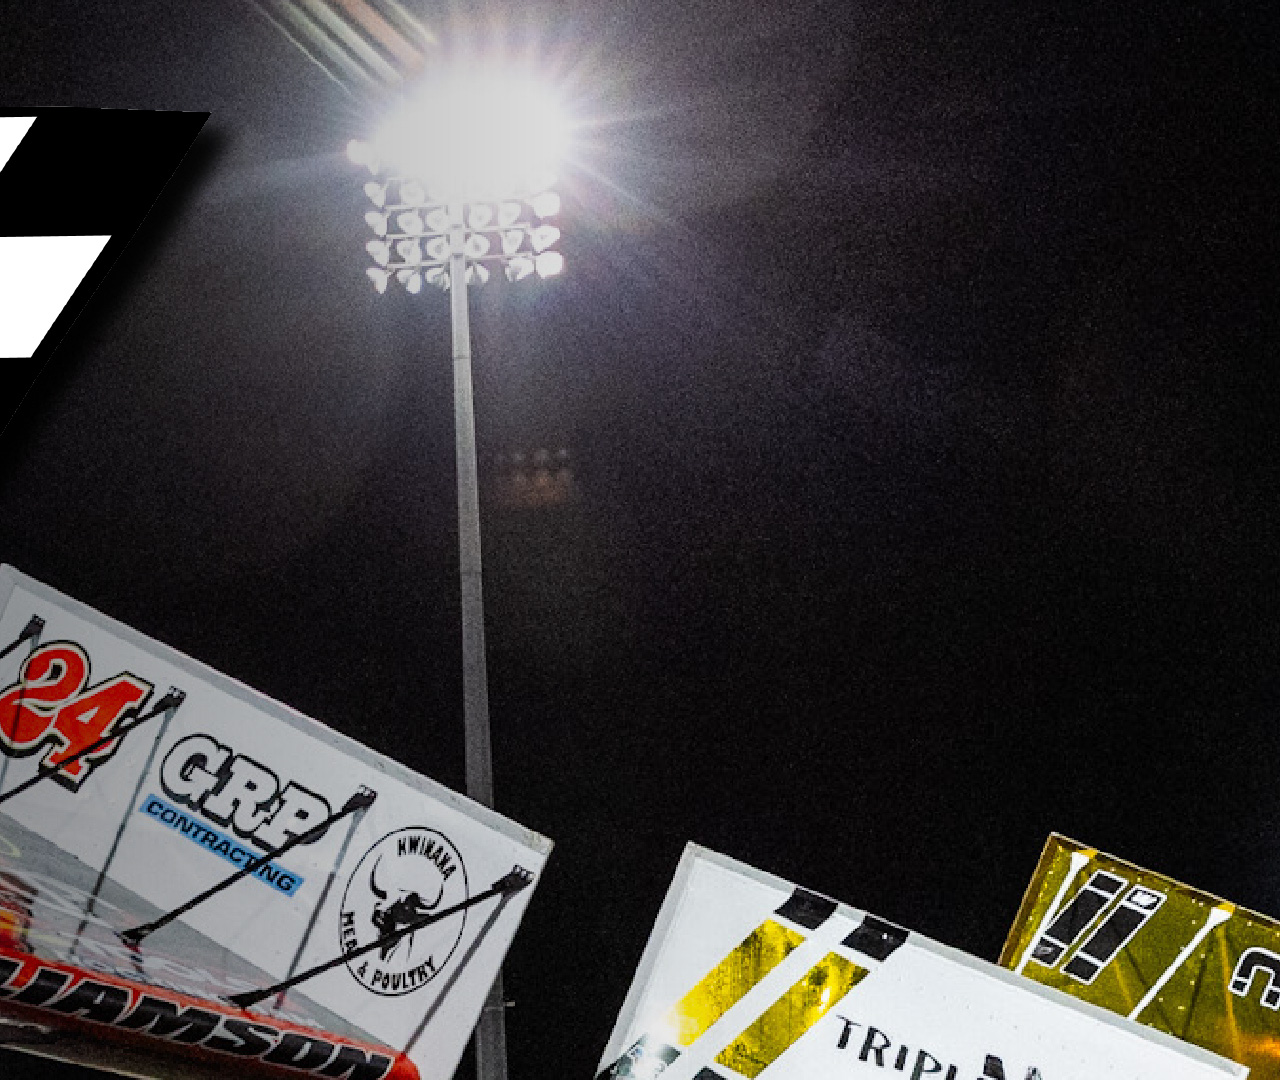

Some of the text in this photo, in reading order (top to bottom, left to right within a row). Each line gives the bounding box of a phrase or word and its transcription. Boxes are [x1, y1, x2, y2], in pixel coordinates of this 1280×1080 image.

[161, 734, 331, 855] GRP
[147, 800, 298, 893] CONTRACTING
[371, 955, 436, 990] POULTRY
